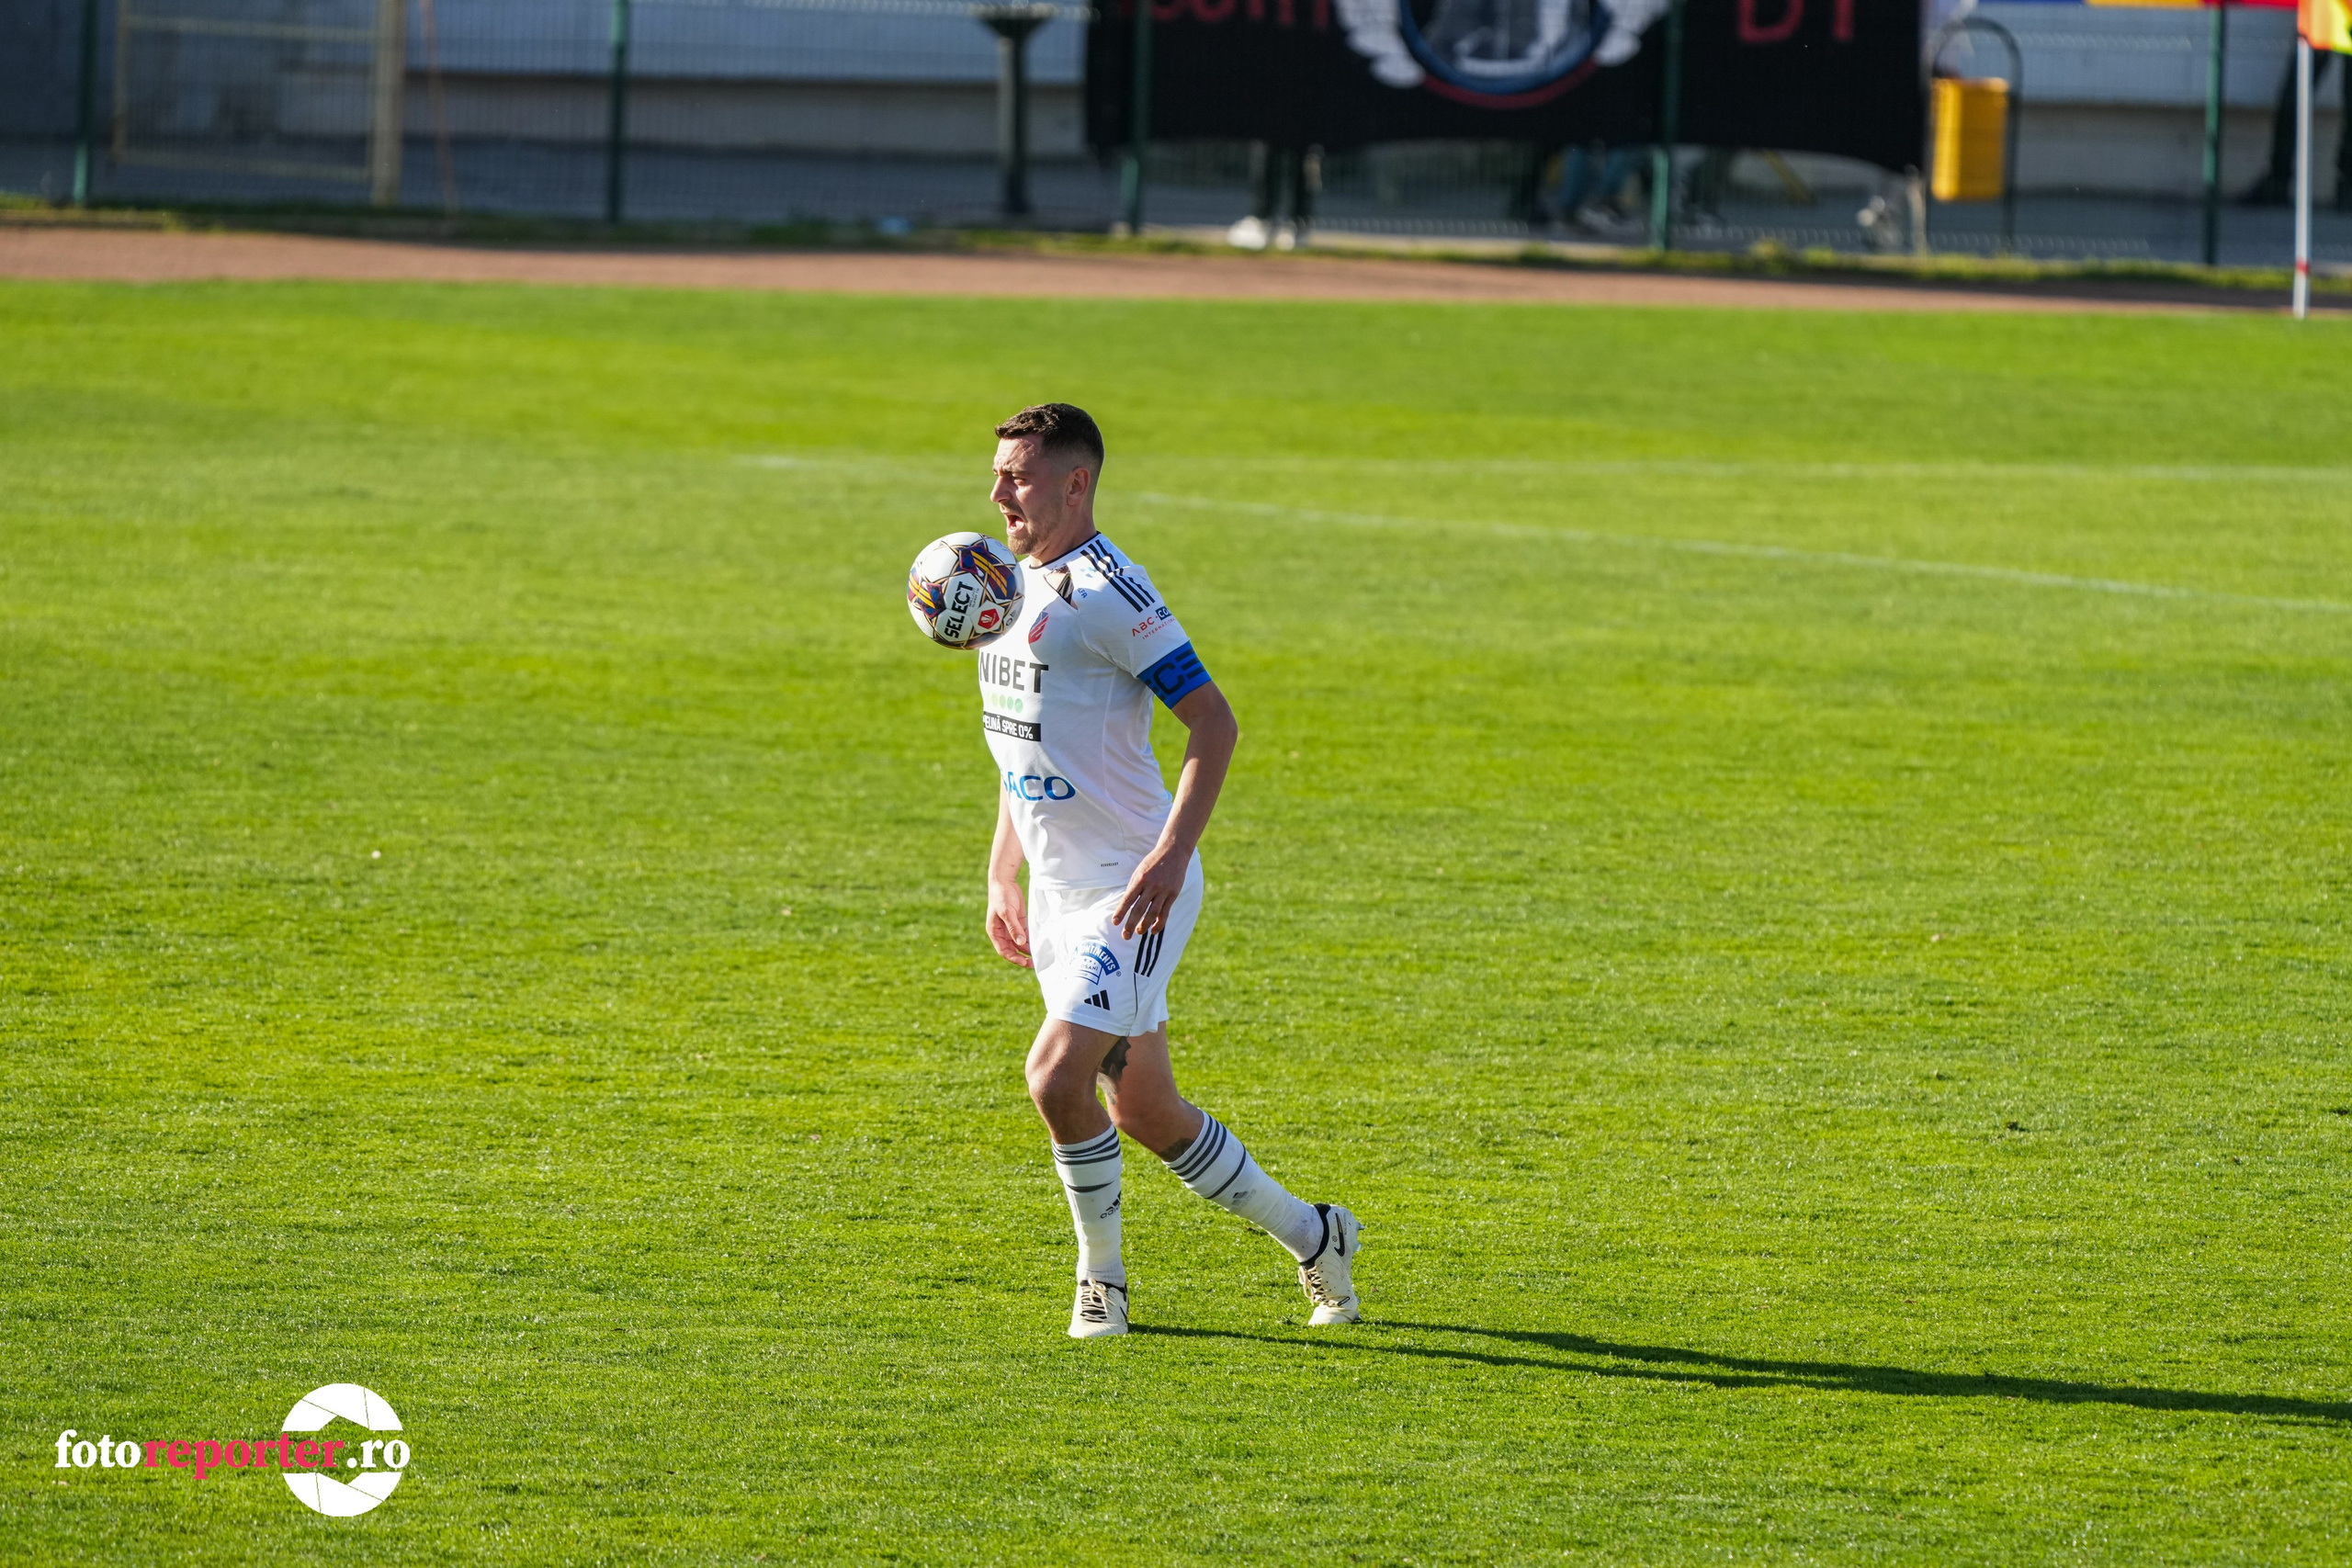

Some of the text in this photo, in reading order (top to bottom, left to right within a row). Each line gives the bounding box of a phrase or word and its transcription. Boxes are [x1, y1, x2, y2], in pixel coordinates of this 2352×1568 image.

[944, 581, 974, 639] SELECT
[1001, 719, 1018, 737] SPRE
[1018, 725, 1034, 740] 0%
